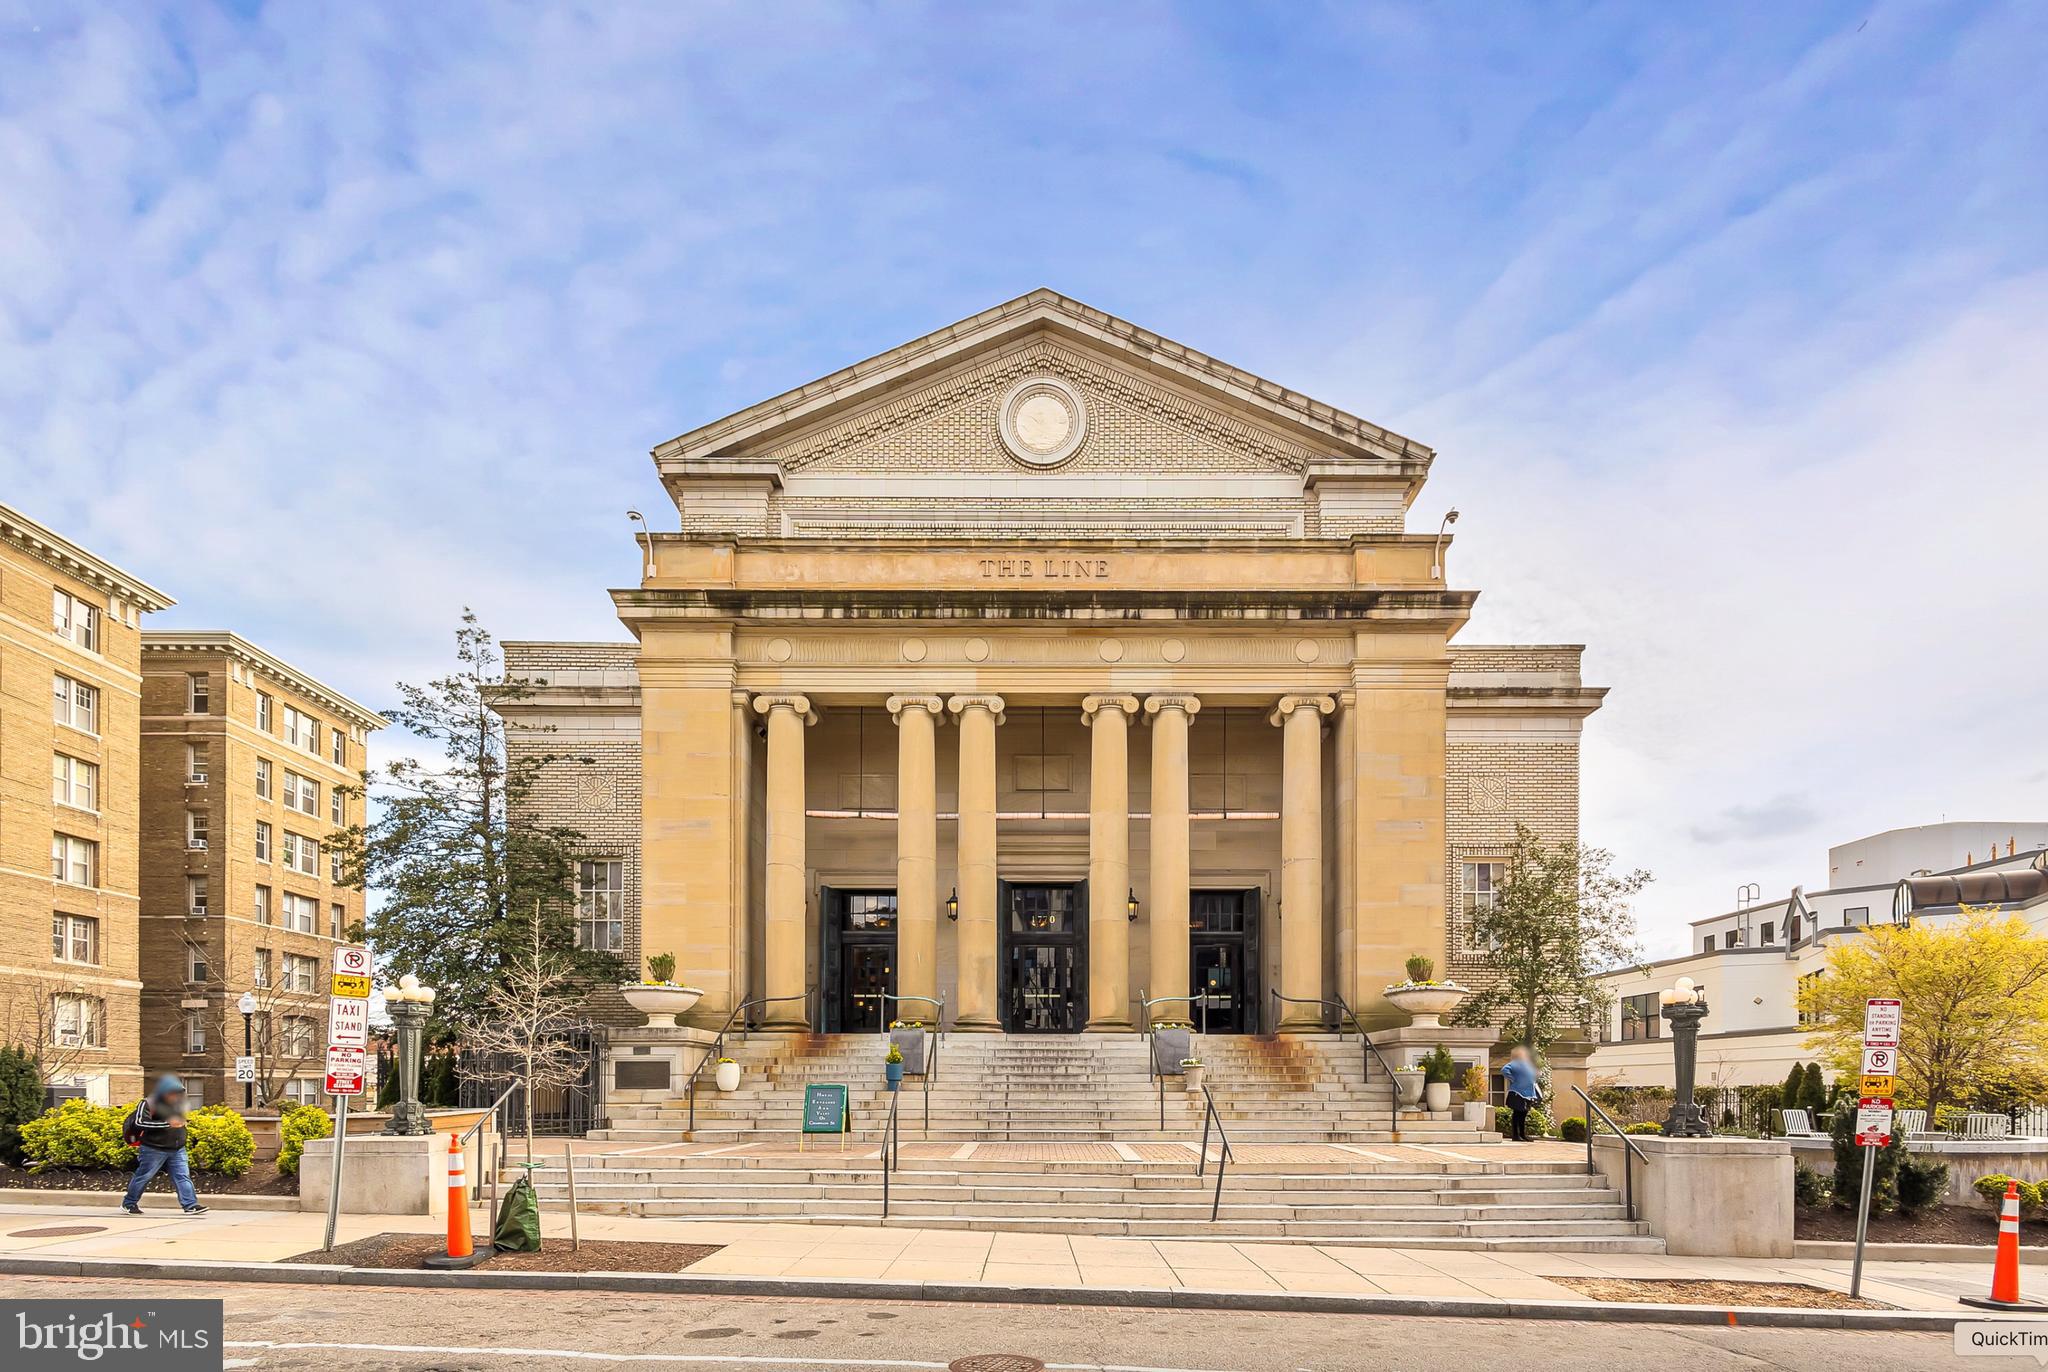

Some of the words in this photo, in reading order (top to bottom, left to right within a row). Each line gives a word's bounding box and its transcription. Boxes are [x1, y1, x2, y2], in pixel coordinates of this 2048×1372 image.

[979, 560, 1033, 577] THE
[1045, 560, 1109, 577] LINE
[337, 1004, 360, 1016] TAXI
[335, 1021, 362, 1032] STAND
[238, 1070, 254, 1079] 20
